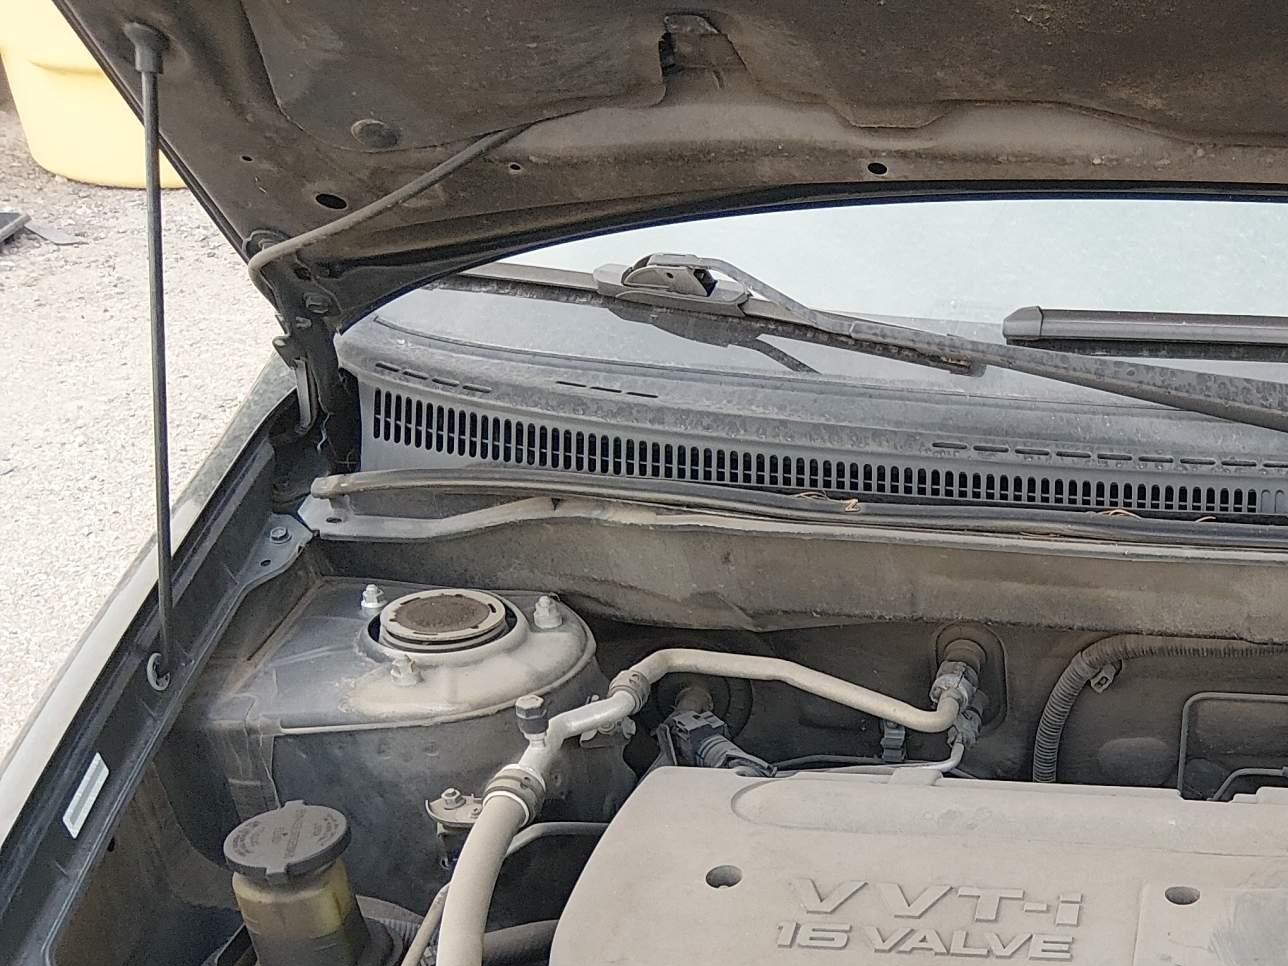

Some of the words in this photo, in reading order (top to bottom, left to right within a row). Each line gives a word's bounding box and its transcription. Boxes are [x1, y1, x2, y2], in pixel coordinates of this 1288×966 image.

[796, 877, 1083, 927] VVT-i
[777, 922, 852, 949] 16
[866, 928, 1074, 961] VALVE
